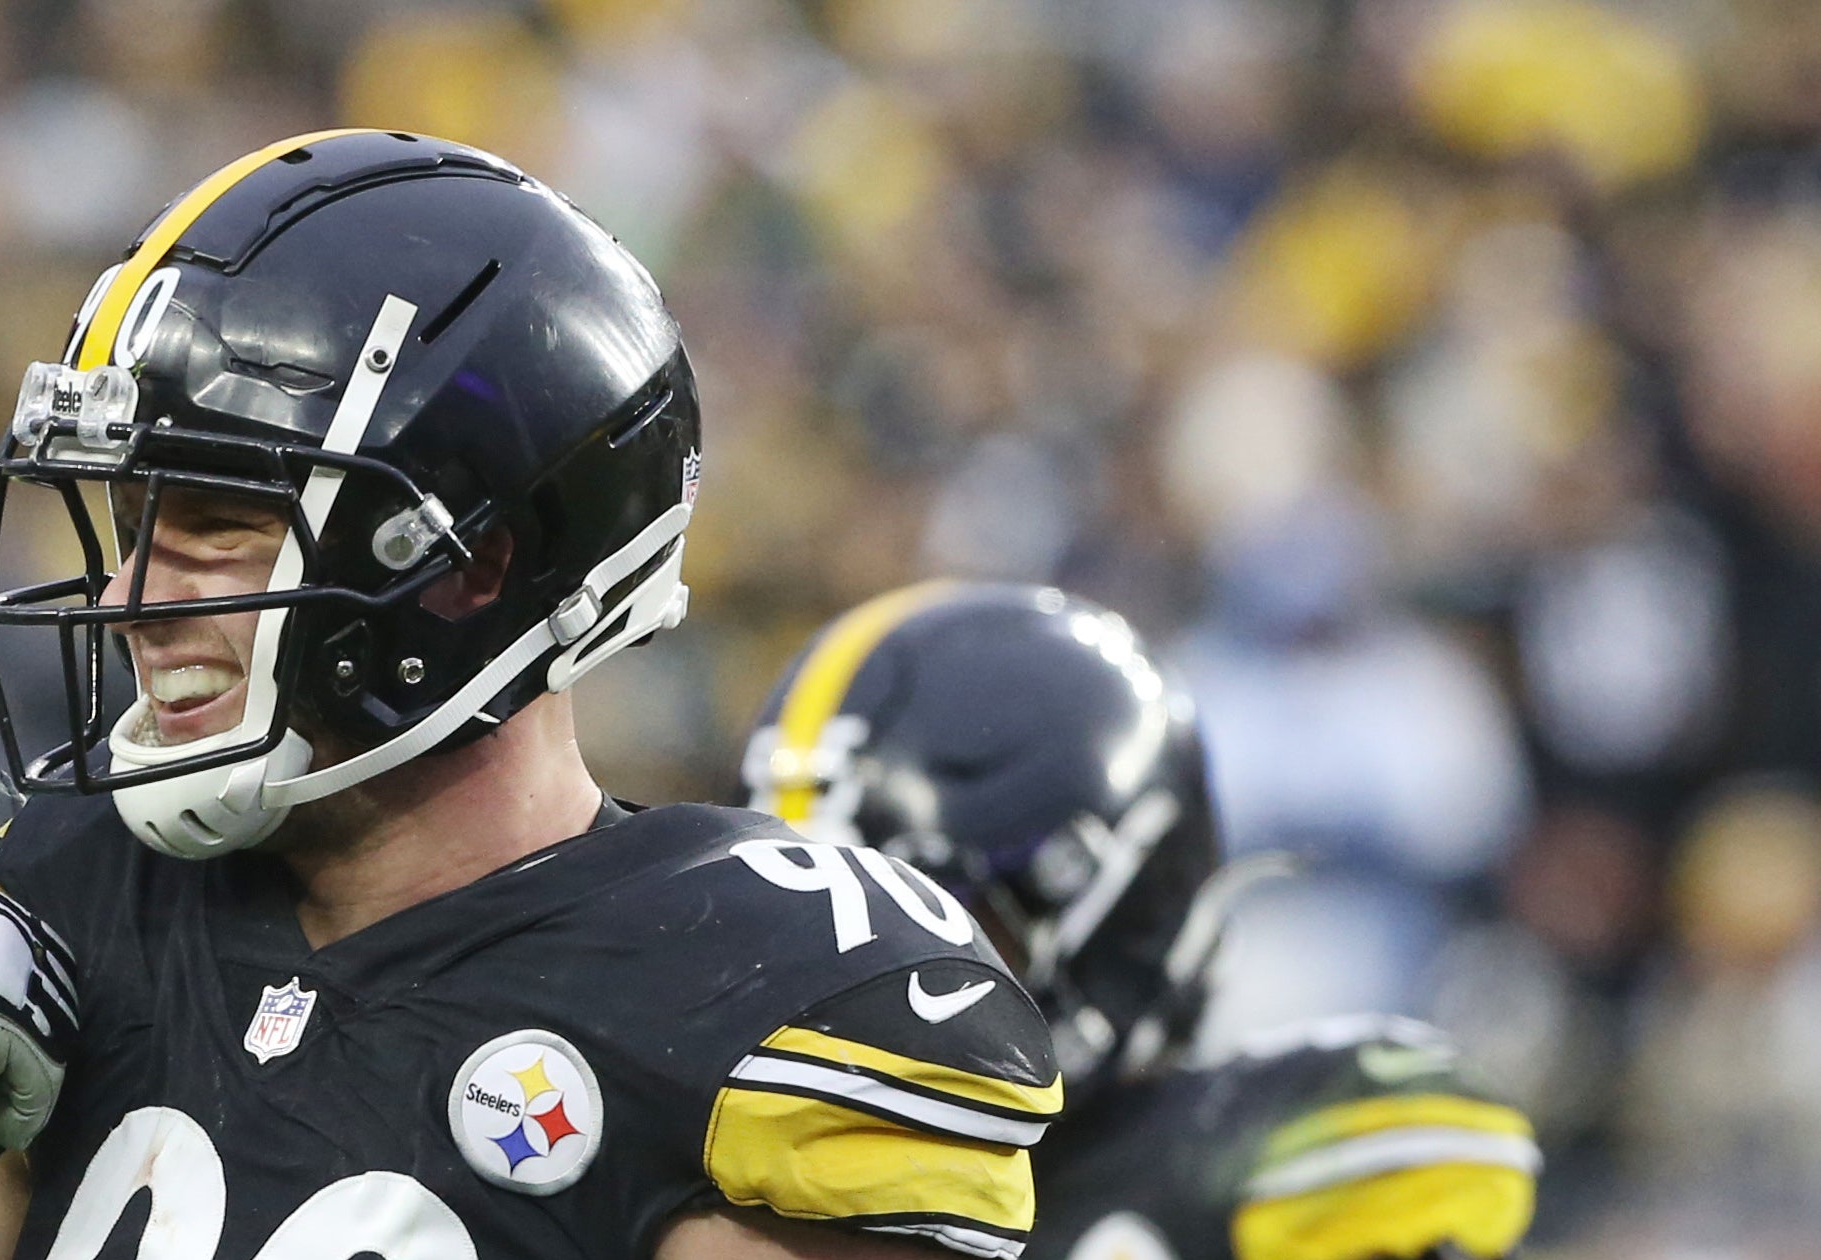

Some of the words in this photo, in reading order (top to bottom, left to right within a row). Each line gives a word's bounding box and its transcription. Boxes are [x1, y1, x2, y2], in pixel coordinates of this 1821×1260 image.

[728, 838, 974, 955] 90
[253, 1014, 292, 1047] NFL
[465, 1082, 521, 1117] Steelers
